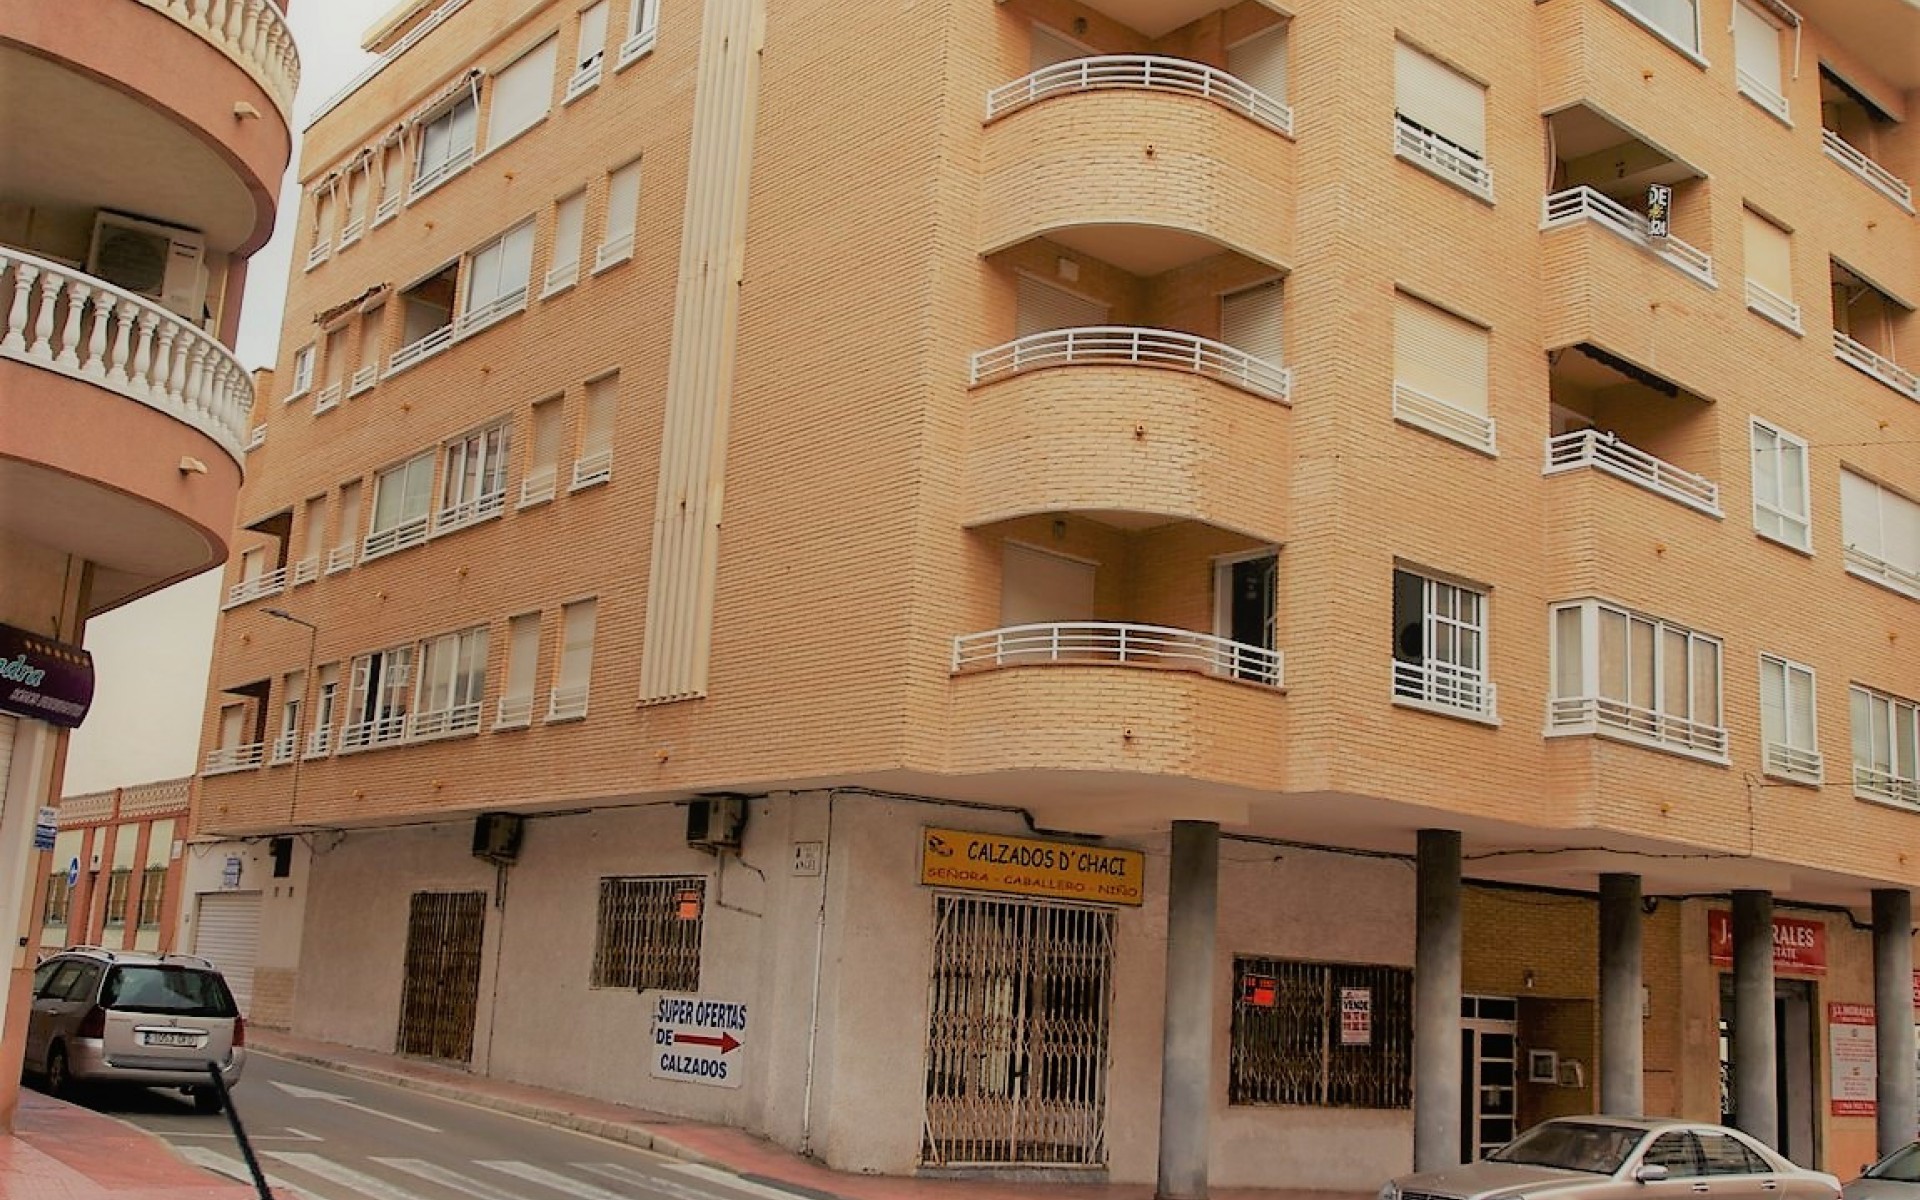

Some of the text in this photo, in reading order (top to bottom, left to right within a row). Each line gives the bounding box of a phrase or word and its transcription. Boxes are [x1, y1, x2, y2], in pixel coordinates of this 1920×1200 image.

[967, 840, 1055, 869] CALZADOS
[927, 868, 989, 882] SEÑORA
[1003, 874, 1086, 893] CABALLERO
[1097, 884, 1138, 898] NIÑO
[658, 998, 747, 1031] SUPER OFERTAS
[656, 1028, 674, 1046] DE
[660, 1053, 727, 1080] CALZADOS
